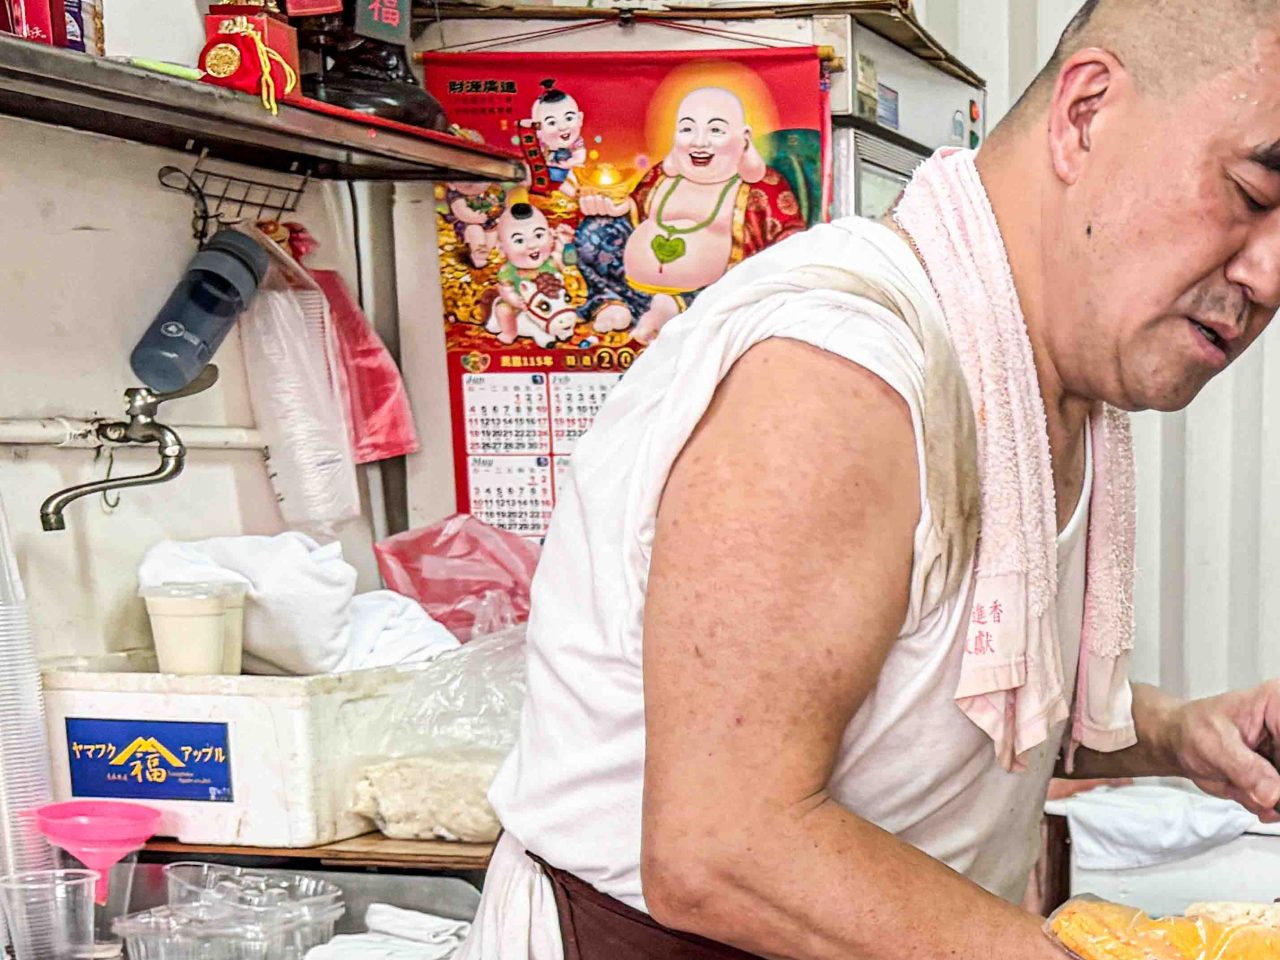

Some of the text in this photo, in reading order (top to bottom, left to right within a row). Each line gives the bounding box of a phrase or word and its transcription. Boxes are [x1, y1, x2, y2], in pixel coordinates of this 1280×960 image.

[72, 742, 116, 760] ヤマフク
[129, 752, 168, 784] 福
